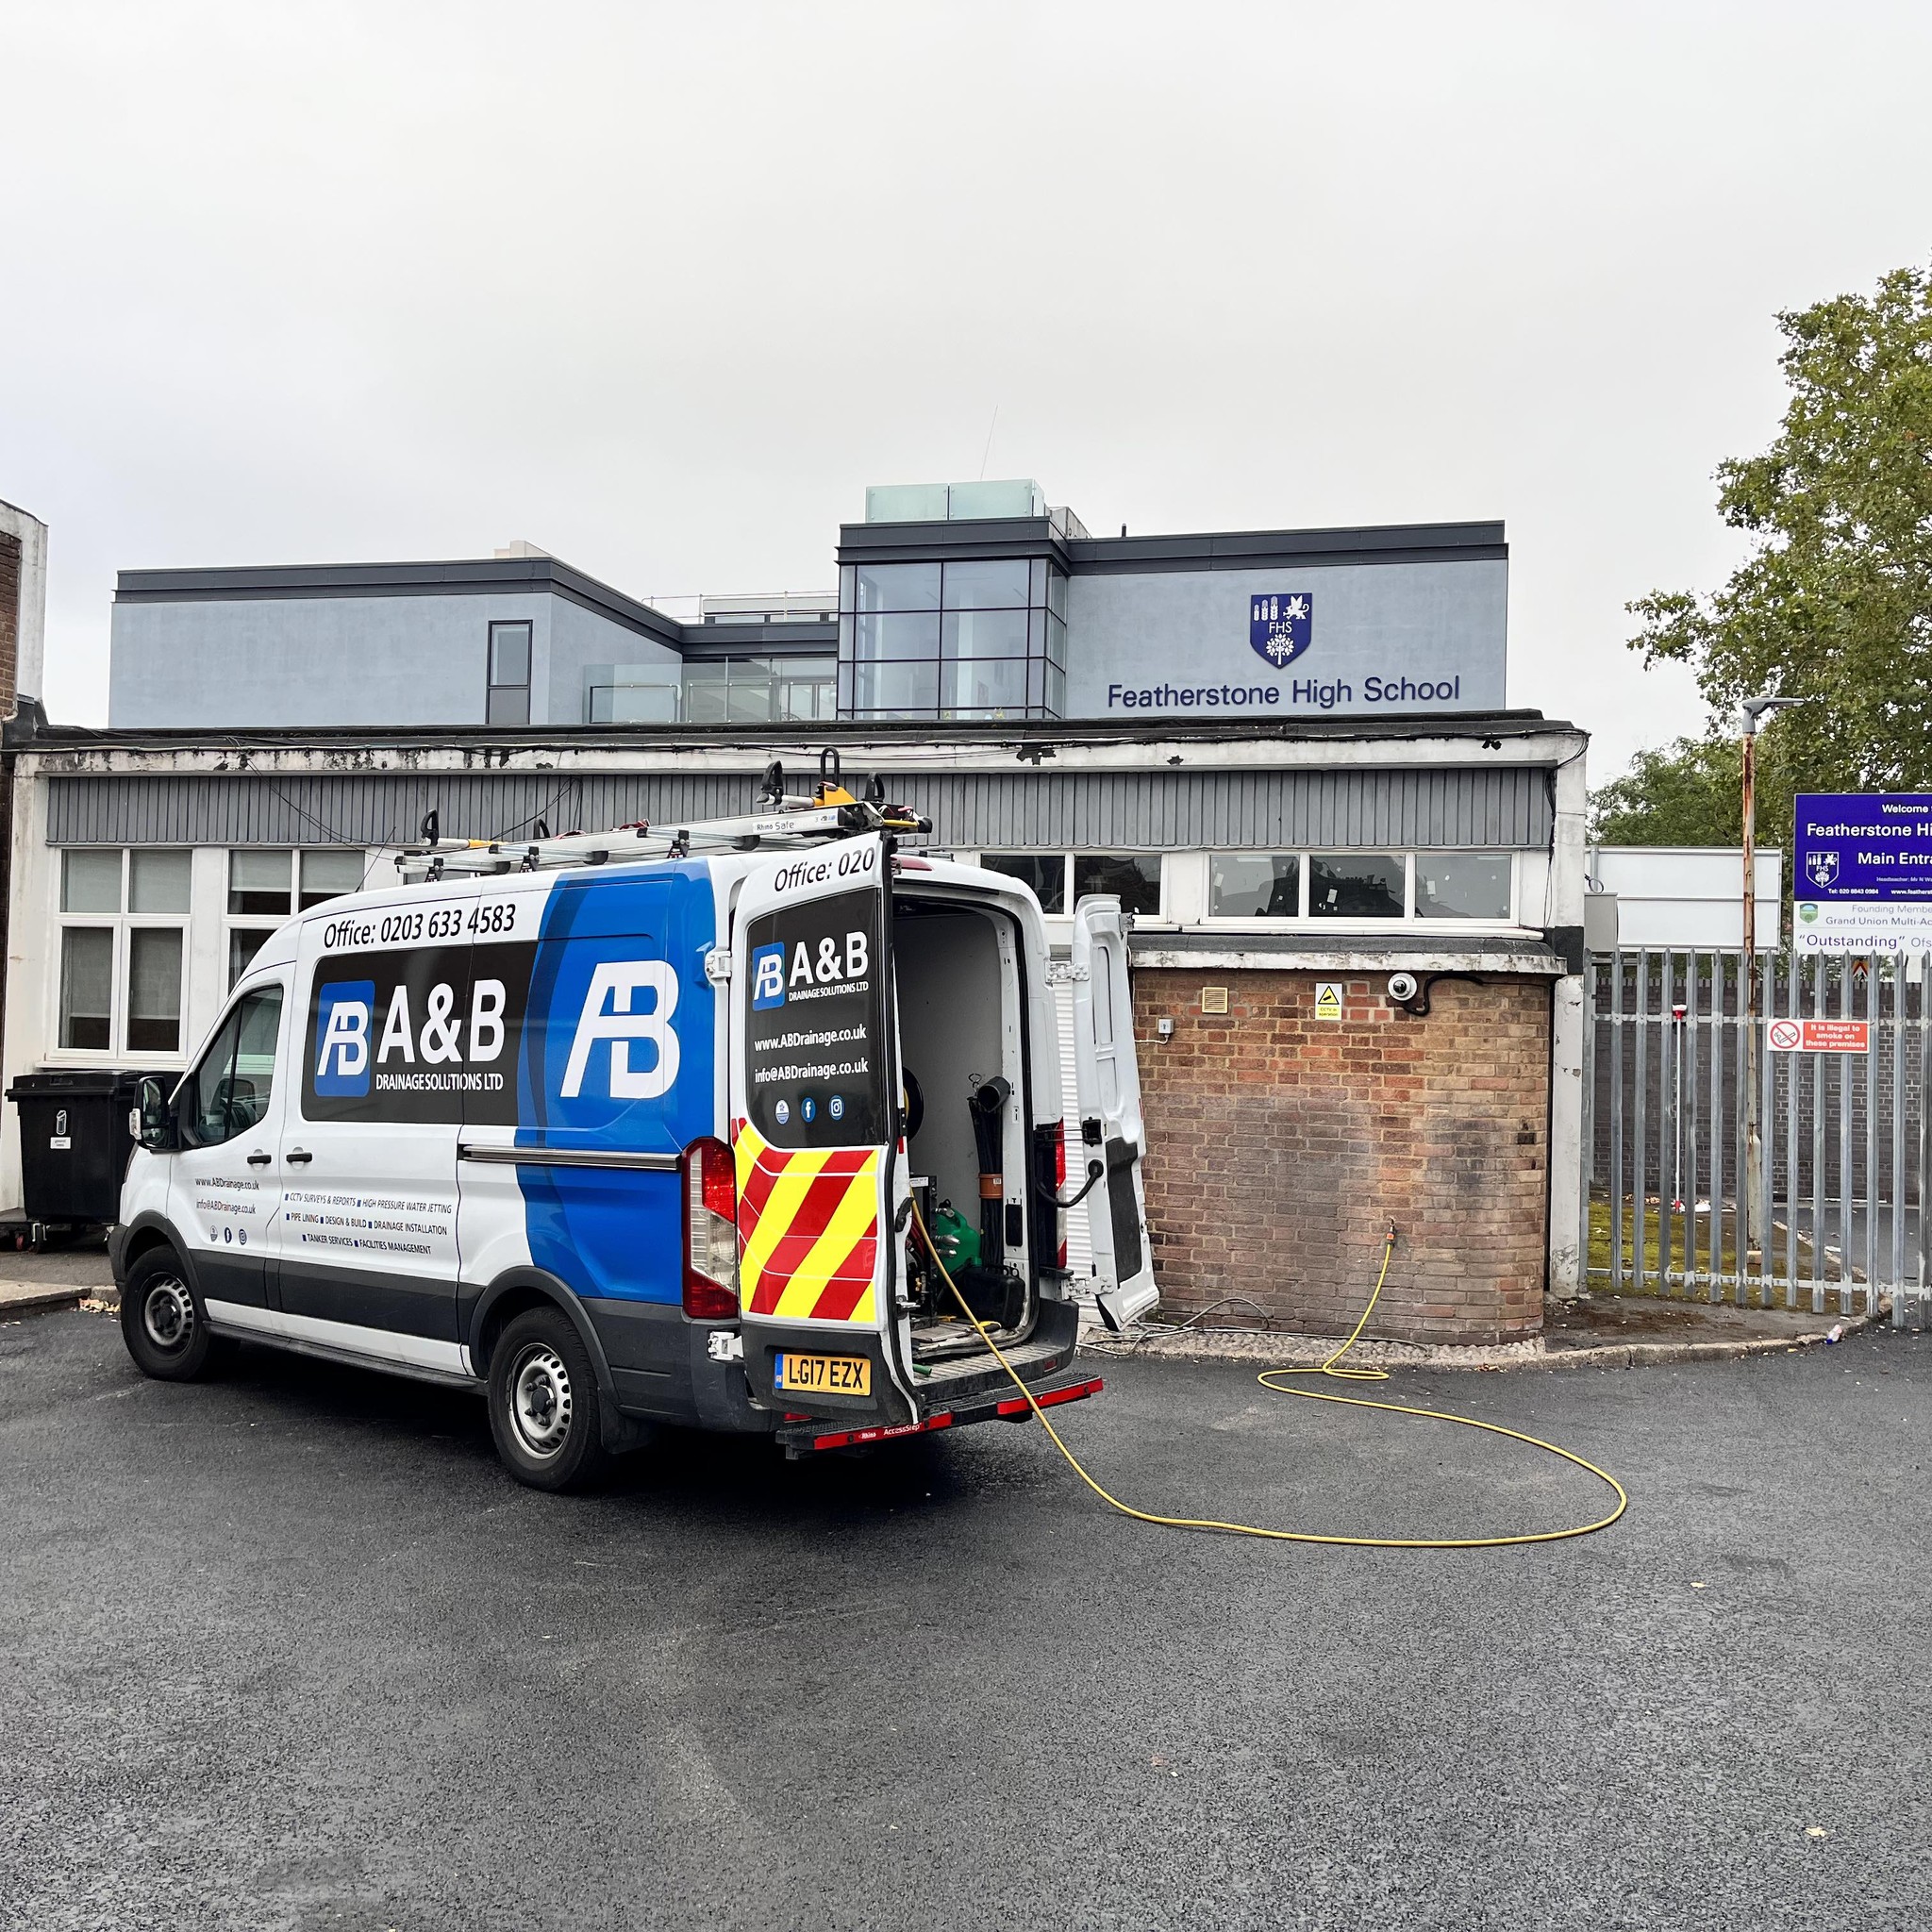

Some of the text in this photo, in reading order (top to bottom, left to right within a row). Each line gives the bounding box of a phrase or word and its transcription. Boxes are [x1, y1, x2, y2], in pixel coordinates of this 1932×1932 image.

[1269, 622, 1292, 634] FHS
[1108, 675, 1459, 709] Featherstone High School
[1882, 804, 1929, 813] Welcome
[774, 821, 795, 831] Safe
[1807, 823, 1912, 837] Featherstone
[1857, 852, 1895, 865] Main
[774, 846, 874, 891] Office: 020
[1852, 905, 1894, 915] Founding
[325, 904, 516, 948] Office: 0203 633 4583
[1825, 917, 1856, 925] Grand
[1858, 917, 1888, 925] Union
[1910, 937, 1932, 948] Ofs
[789, 931, 869, 987] A&B
[856, 981, 869, 992] LTD
[377, 979, 506, 1064] A&B
[1826, 1024, 1850, 1032] illegal
[755, 1024, 867, 1052] www.ABDrainage.co.uk
[1829, 1041, 1866, 1049] premises
[755, 1058, 868, 1084] info@ABDrainage.co.uk
[483, 1074, 503, 1090] LTD
[195, 1177, 259, 1191] www.ABDrainage.co.uk
[196, 1199, 256, 1215] info@ABDrainage.co.uk
[290, 1192, 302, 1201] CCTV
[304, 1194, 326, 1204] SURVEYS
[332, 1196, 356, 1207] REPORTS
[362, 1199, 376, 1208] HIGH
[377, 1200, 405, 1210] PRESSURE
[406, 1202, 426, 1212] WATER
[427, 1204, 452, 1214] JETTING
[291, 1212, 301, 1221] PIPE
[302, 1214, 319, 1224] LINING
[325, 1216, 344, 1225] DESIGN
[351, 1218, 367, 1228] BUILD
[374, 1220, 404, 1232] DRAINAGE
[405, 1223, 447, 1236] INSTALLATION
[307, 1233, 431, 1255] TANKER SERVICES FACILITIES MANAGEMENT
[789, 1357, 864, 1389] LG17 EZX
